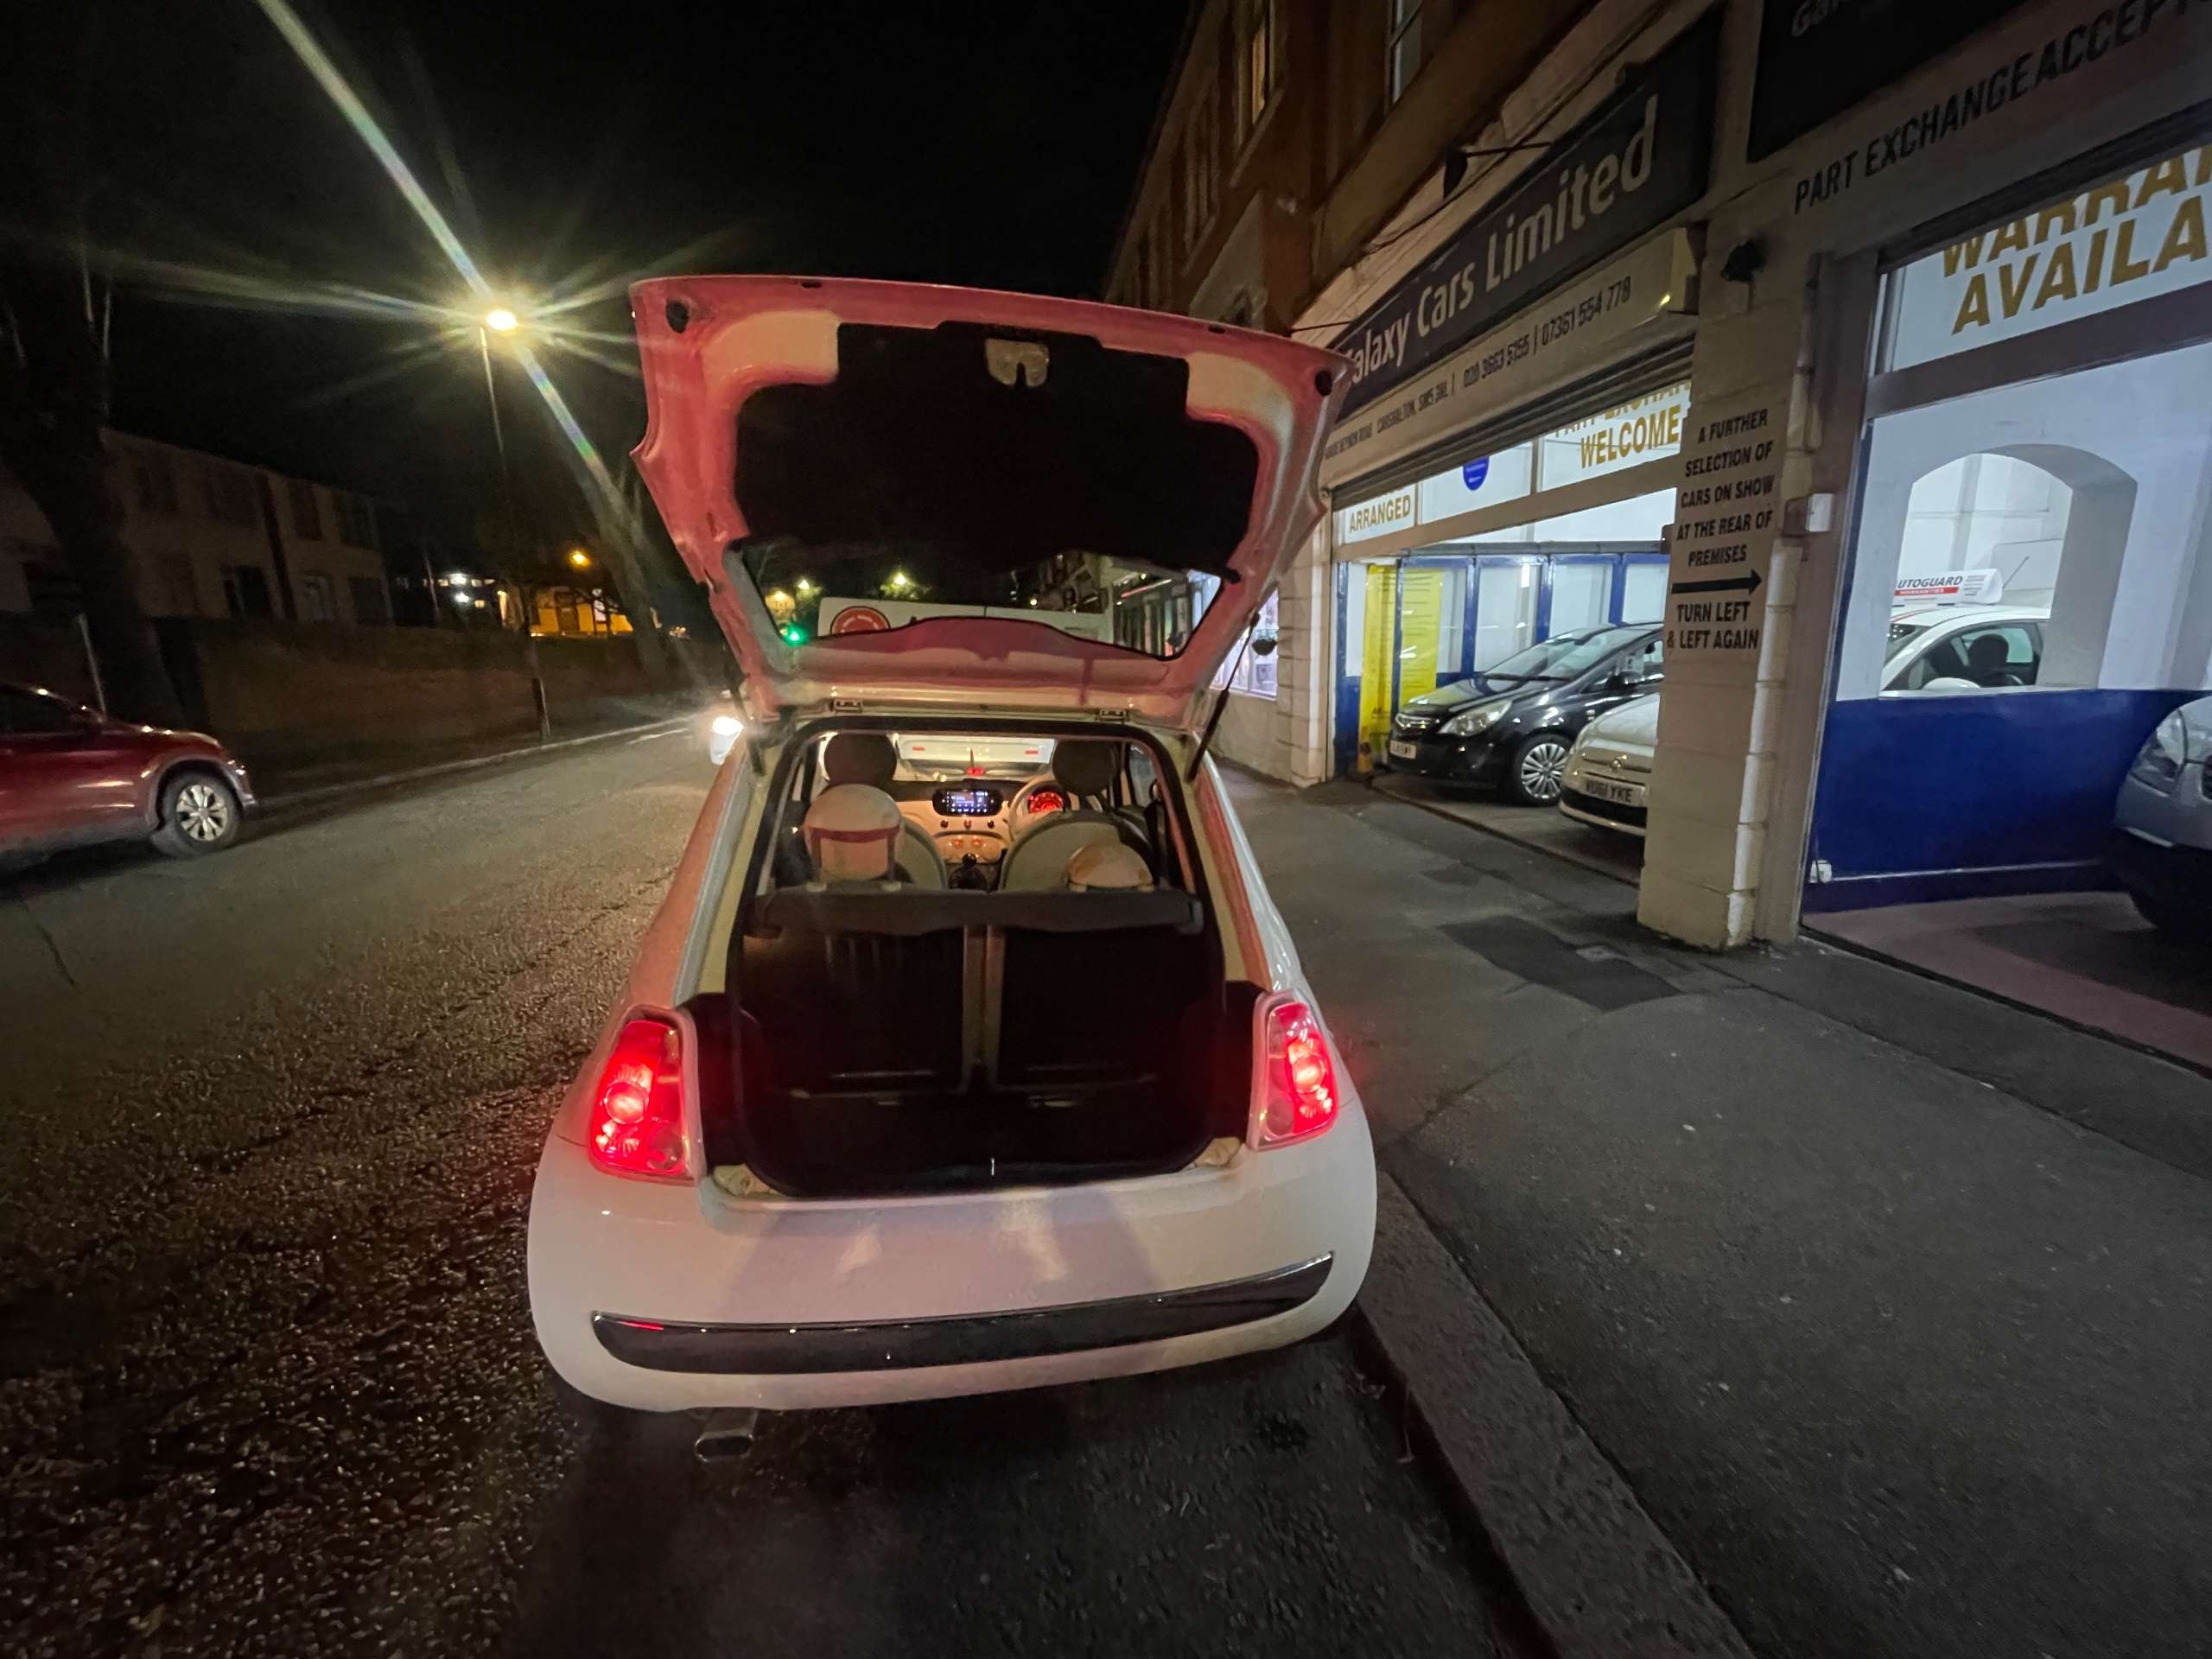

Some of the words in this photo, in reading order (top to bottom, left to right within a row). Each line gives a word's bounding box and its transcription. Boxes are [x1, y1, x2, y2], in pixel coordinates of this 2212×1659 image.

[1795, 149, 1858, 215] PART
[1865, 52, 2033, 178] EXCHANGE
[1943, 143, 2212, 278] WARRA
[1345, 310, 1412, 385] alaxy
[1417, 262, 1477, 338] Cars
[1485, 92, 1659, 293] Limited
[1950, 194, 2208, 335] AVAILA
[1580, 404, 1681, 468] WELCOME
[1698, 426, 1706, 444] A
[1709, 408, 1768, 441] FURTHER
[1685, 446, 1751, 477] SELECTION
[1755, 441, 1774, 462] OF
[1681, 488, 1711, 508] CARS
[1714, 484, 1732, 503] ON
[1735, 474, 1776, 499] SHOW
[1349, 494, 1411, 533] ARRANGED
[1676, 524, 1691, 541] AT
[1694, 520, 1715, 537] THE
[1719, 513, 1751, 534] REAR
[1755, 510, 1774, 530] OF
[1688, 544, 1747, 567] PREMISES
[1895, 575, 1963, 588] UTOGUARD
[1677, 602, 1712, 622] TURN
[1715, 601, 1751, 622] LEFT
[1667, 631, 1675, 649] &
[1679, 629, 1711, 649] LEFT
[1713, 629, 1759, 649] AGAIN
